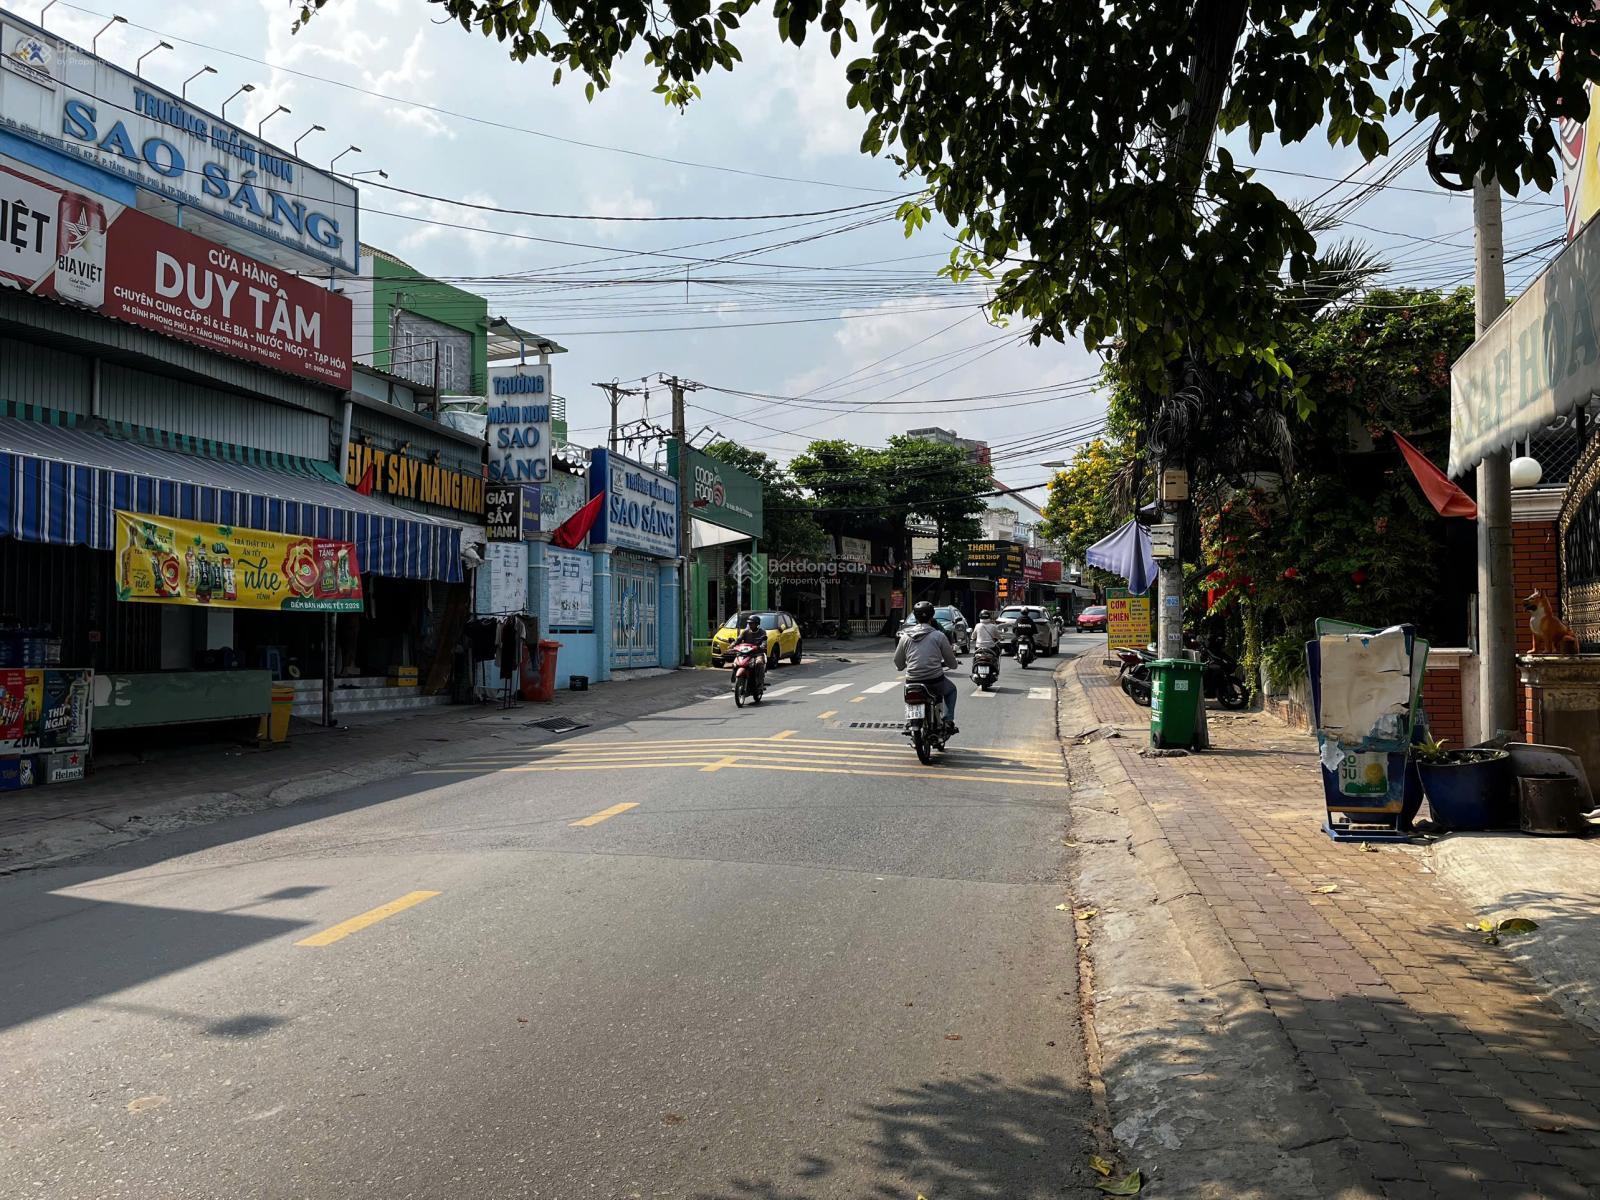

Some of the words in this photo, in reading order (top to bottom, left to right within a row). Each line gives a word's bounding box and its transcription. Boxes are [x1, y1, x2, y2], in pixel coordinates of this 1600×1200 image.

[133, 86, 208, 143] TRƯỜNG
[258, 146, 293, 184] NON
[63, 99, 185, 178] SAO
[202, 161, 344, 249] SÁNG
[208, 248, 239, 274] CỬA
[242, 262, 278, 289] HÀNG
[155, 250, 240, 319] DUY
[248, 286, 321, 349] TÂM
[113, 286, 154, 307] CHUYÊN
[155, 299, 182, 317] CUNG
[183, 309, 202, 323] CẤP
[212, 319, 219, 329] &
[233, 326, 249, 339] BIA
[256, 333, 283, 350] NƯỚC
[285, 342, 308, 358] NGỌT
[314, 351, 329, 365] TẠP
[330, 356, 347, 370] HÓA
[122, 304, 131, 313] 94
[131, 306, 149, 319] ĐÌNH
[149, 313, 173, 326] PHONG
[196, 327, 213, 339] TĂNG
[213, 333, 231, 345] NHƠN
[493, 373, 544, 394] TRƯỜNG
[523, 405, 549, 423] NON
[497, 426, 540, 449] SAO
[489, 453, 547, 481] SÁNG
[461, 475, 485, 514] MAI
[486, 489, 515, 507] GIẶT
[695, 482, 713, 503] FOOD
[487, 506, 512, 524] SẤY
[610, 494, 640, 529] SAO
[641, 500, 674, 539] SÁNG
[967, 543, 996, 551] THANH
[238, 557, 281, 595] nhẹ
[1110, 600, 1127, 610] CƠM
[48, 703, 66, 718] THỬ
[44, 716, 69, 730] NGAY
[1342, 768, 1356, 780] JU
